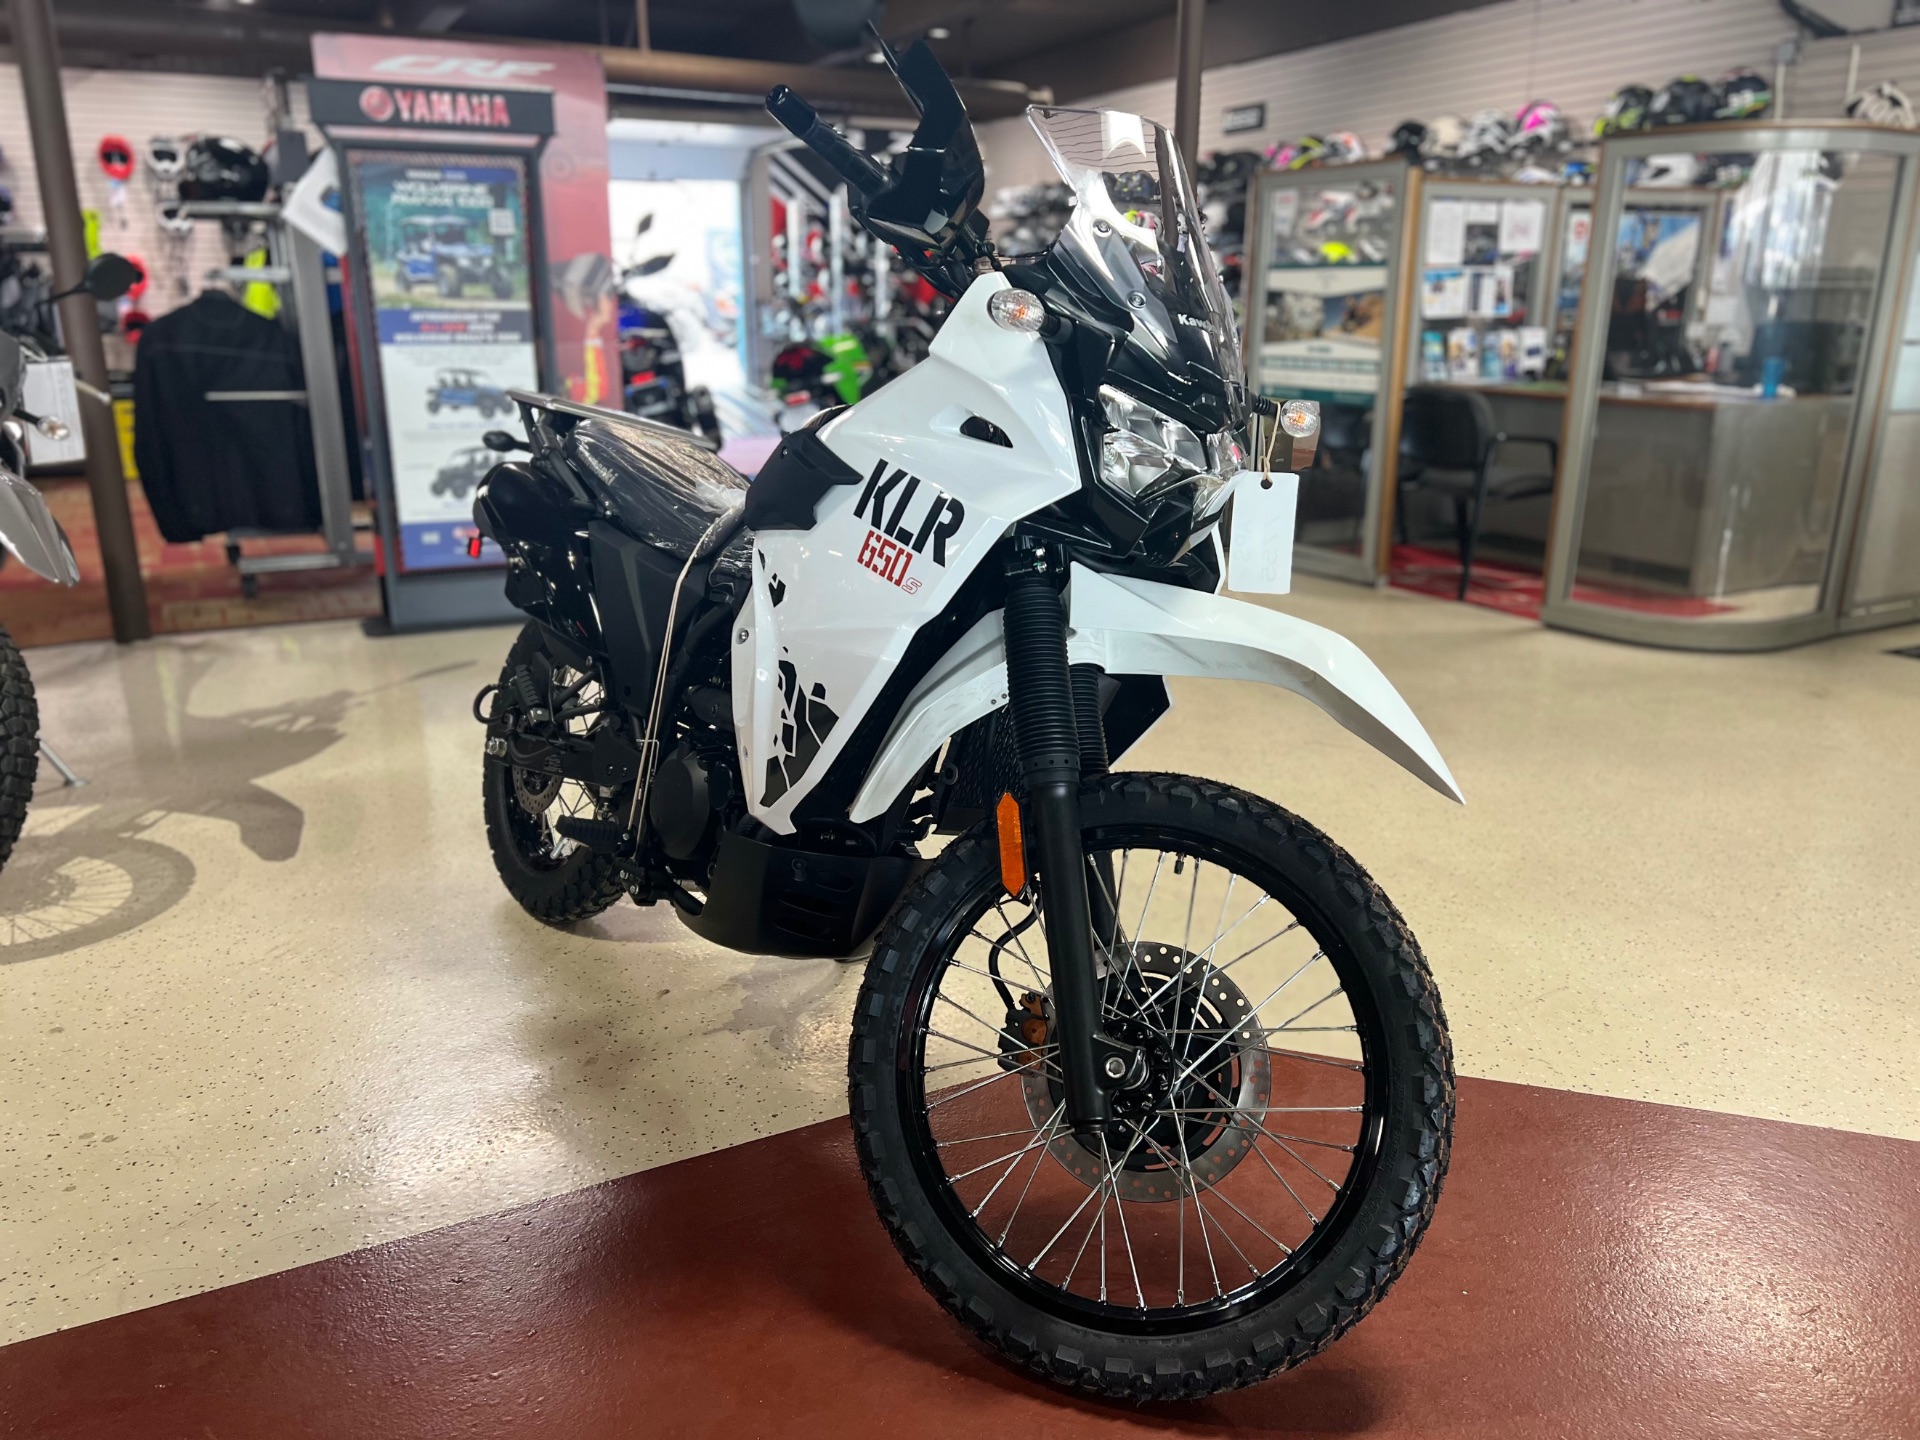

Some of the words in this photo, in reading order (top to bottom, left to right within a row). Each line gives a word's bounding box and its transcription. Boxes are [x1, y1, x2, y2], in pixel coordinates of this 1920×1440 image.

[371, 54, 556, 79] CRF
[393, 89, 511, 127] YAMAHA
[853, 458, 965, 568] KLR
